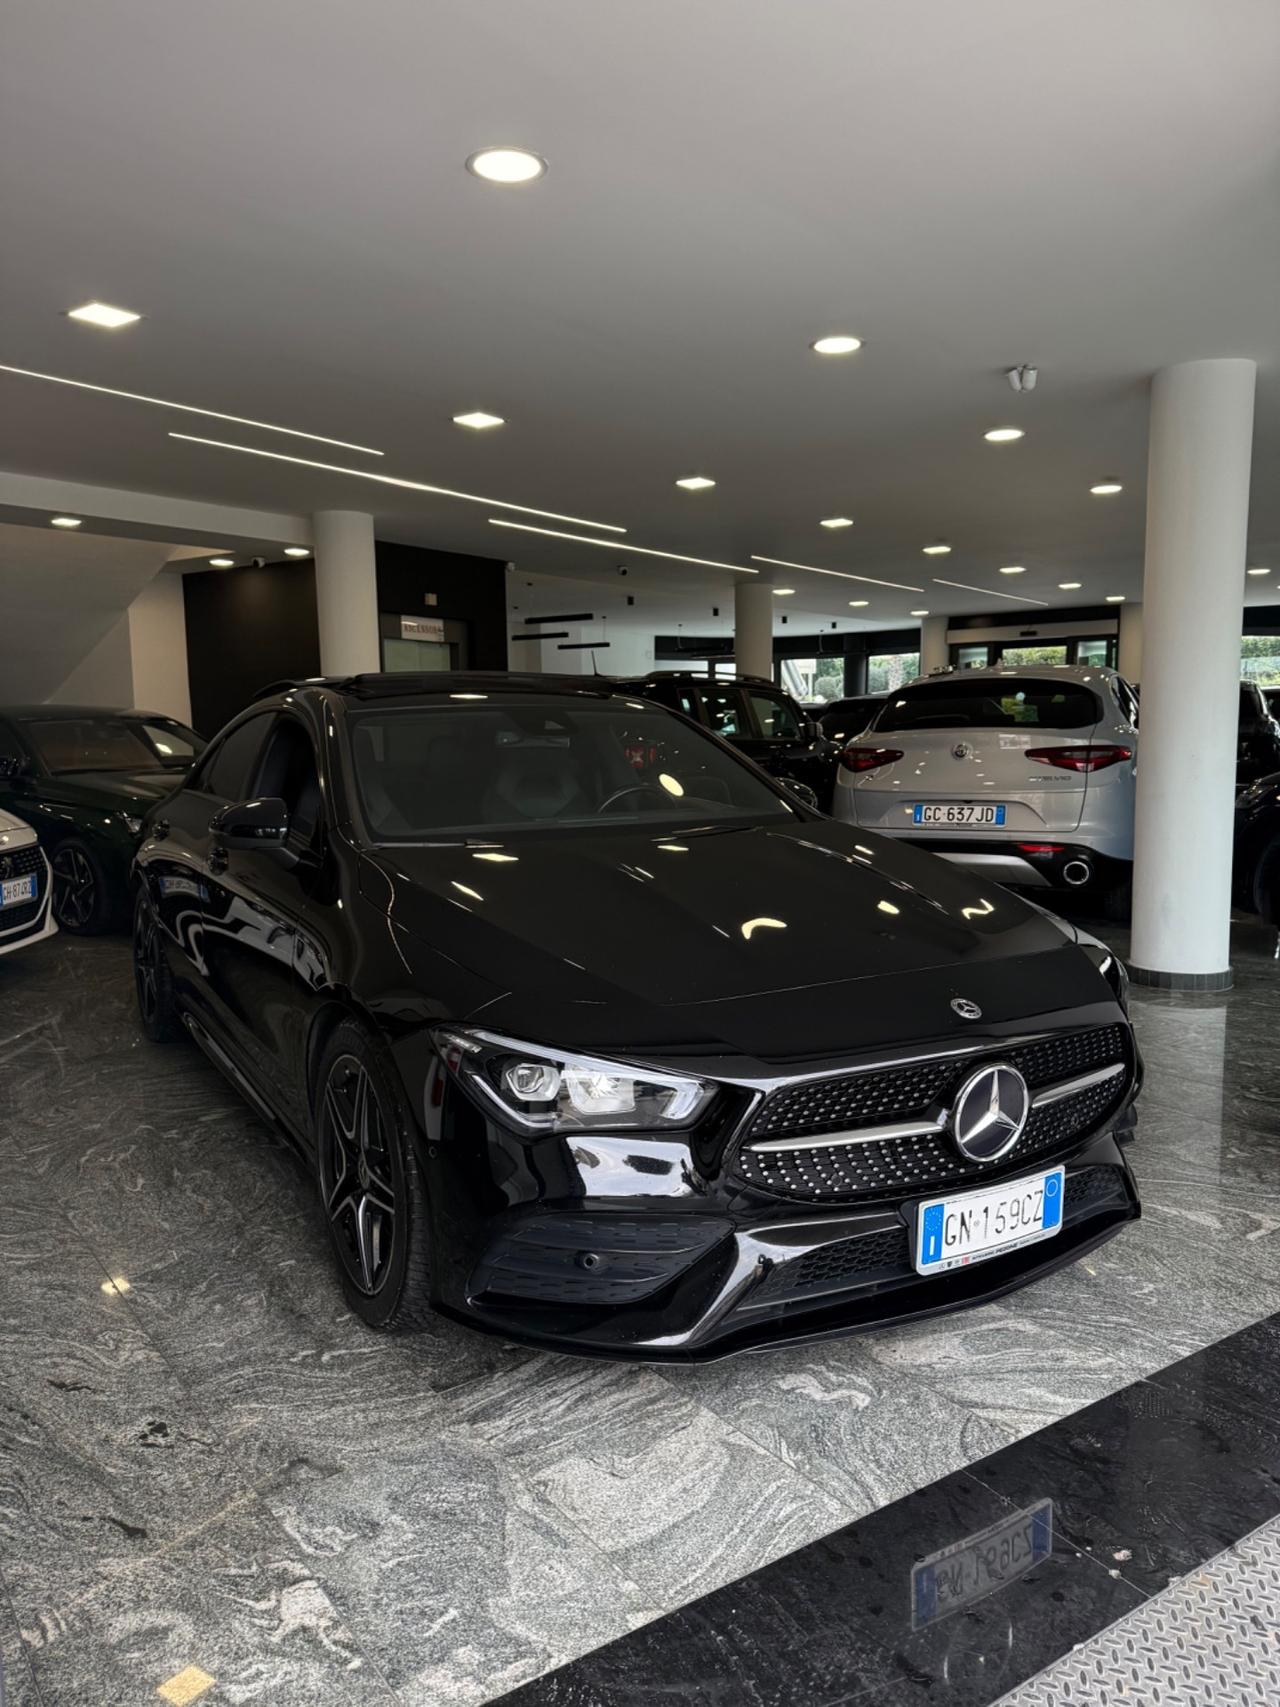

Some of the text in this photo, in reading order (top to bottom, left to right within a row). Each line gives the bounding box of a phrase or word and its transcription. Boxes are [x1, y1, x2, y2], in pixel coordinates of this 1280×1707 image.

[924, 807, 994, 822] GC 637JD
[944, 1189, 1044, 1246] GN 159CZ
